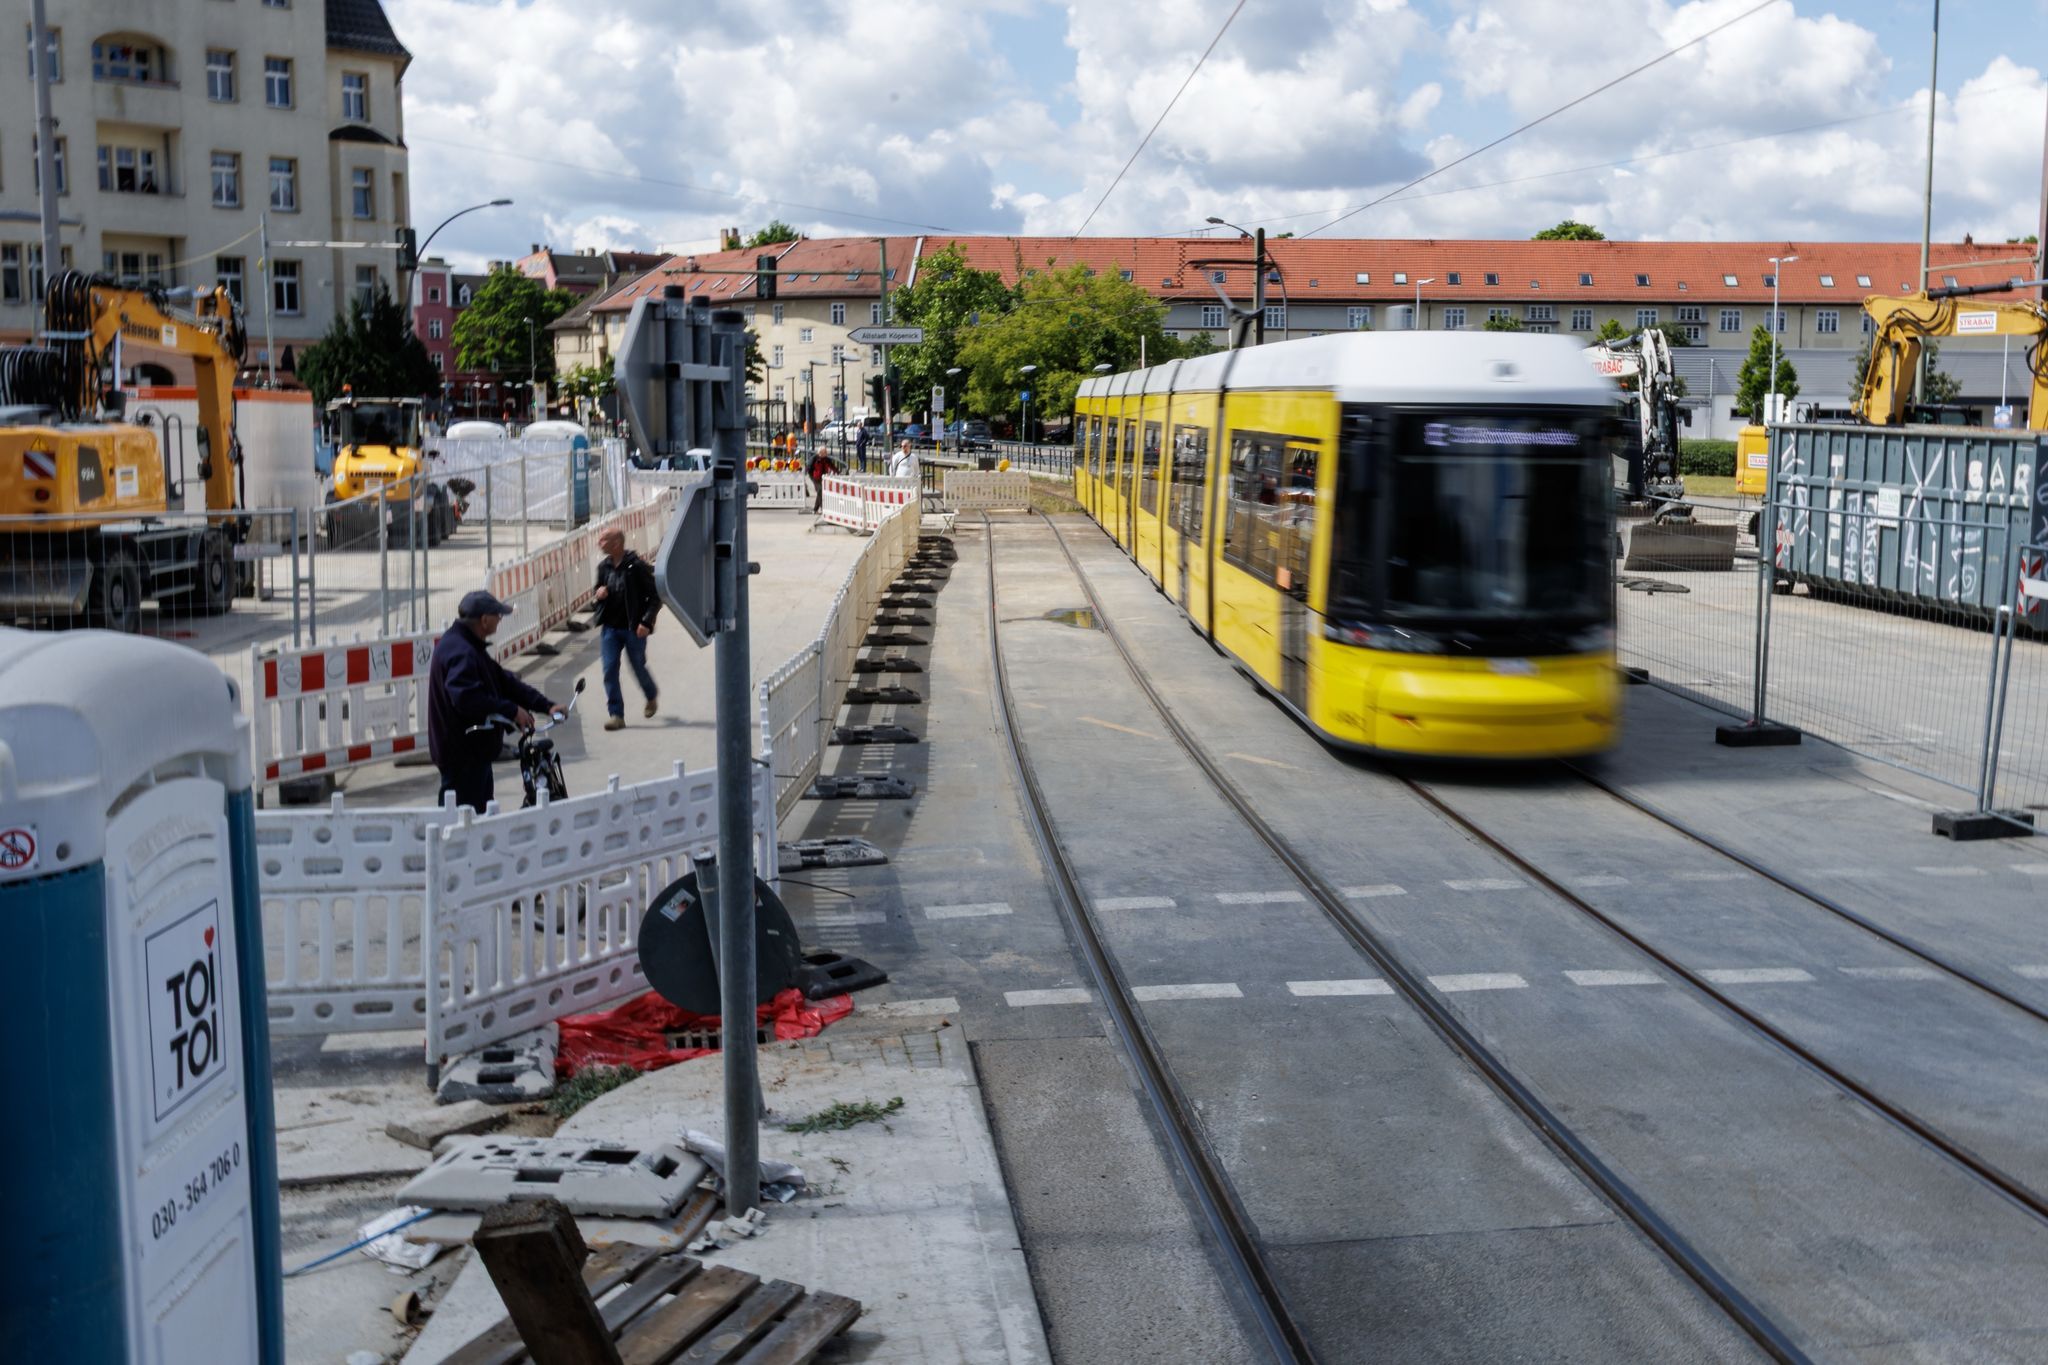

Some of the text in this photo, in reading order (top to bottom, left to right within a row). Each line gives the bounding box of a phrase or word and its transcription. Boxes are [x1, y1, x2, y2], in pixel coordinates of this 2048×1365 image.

[1959, 317, 1993, 327] STRABAG
[349, 471, 397, 479] LIEBHERR
[169, 1008, 219, 1092] TOI
[209, 1149, 231, 1189] 706
